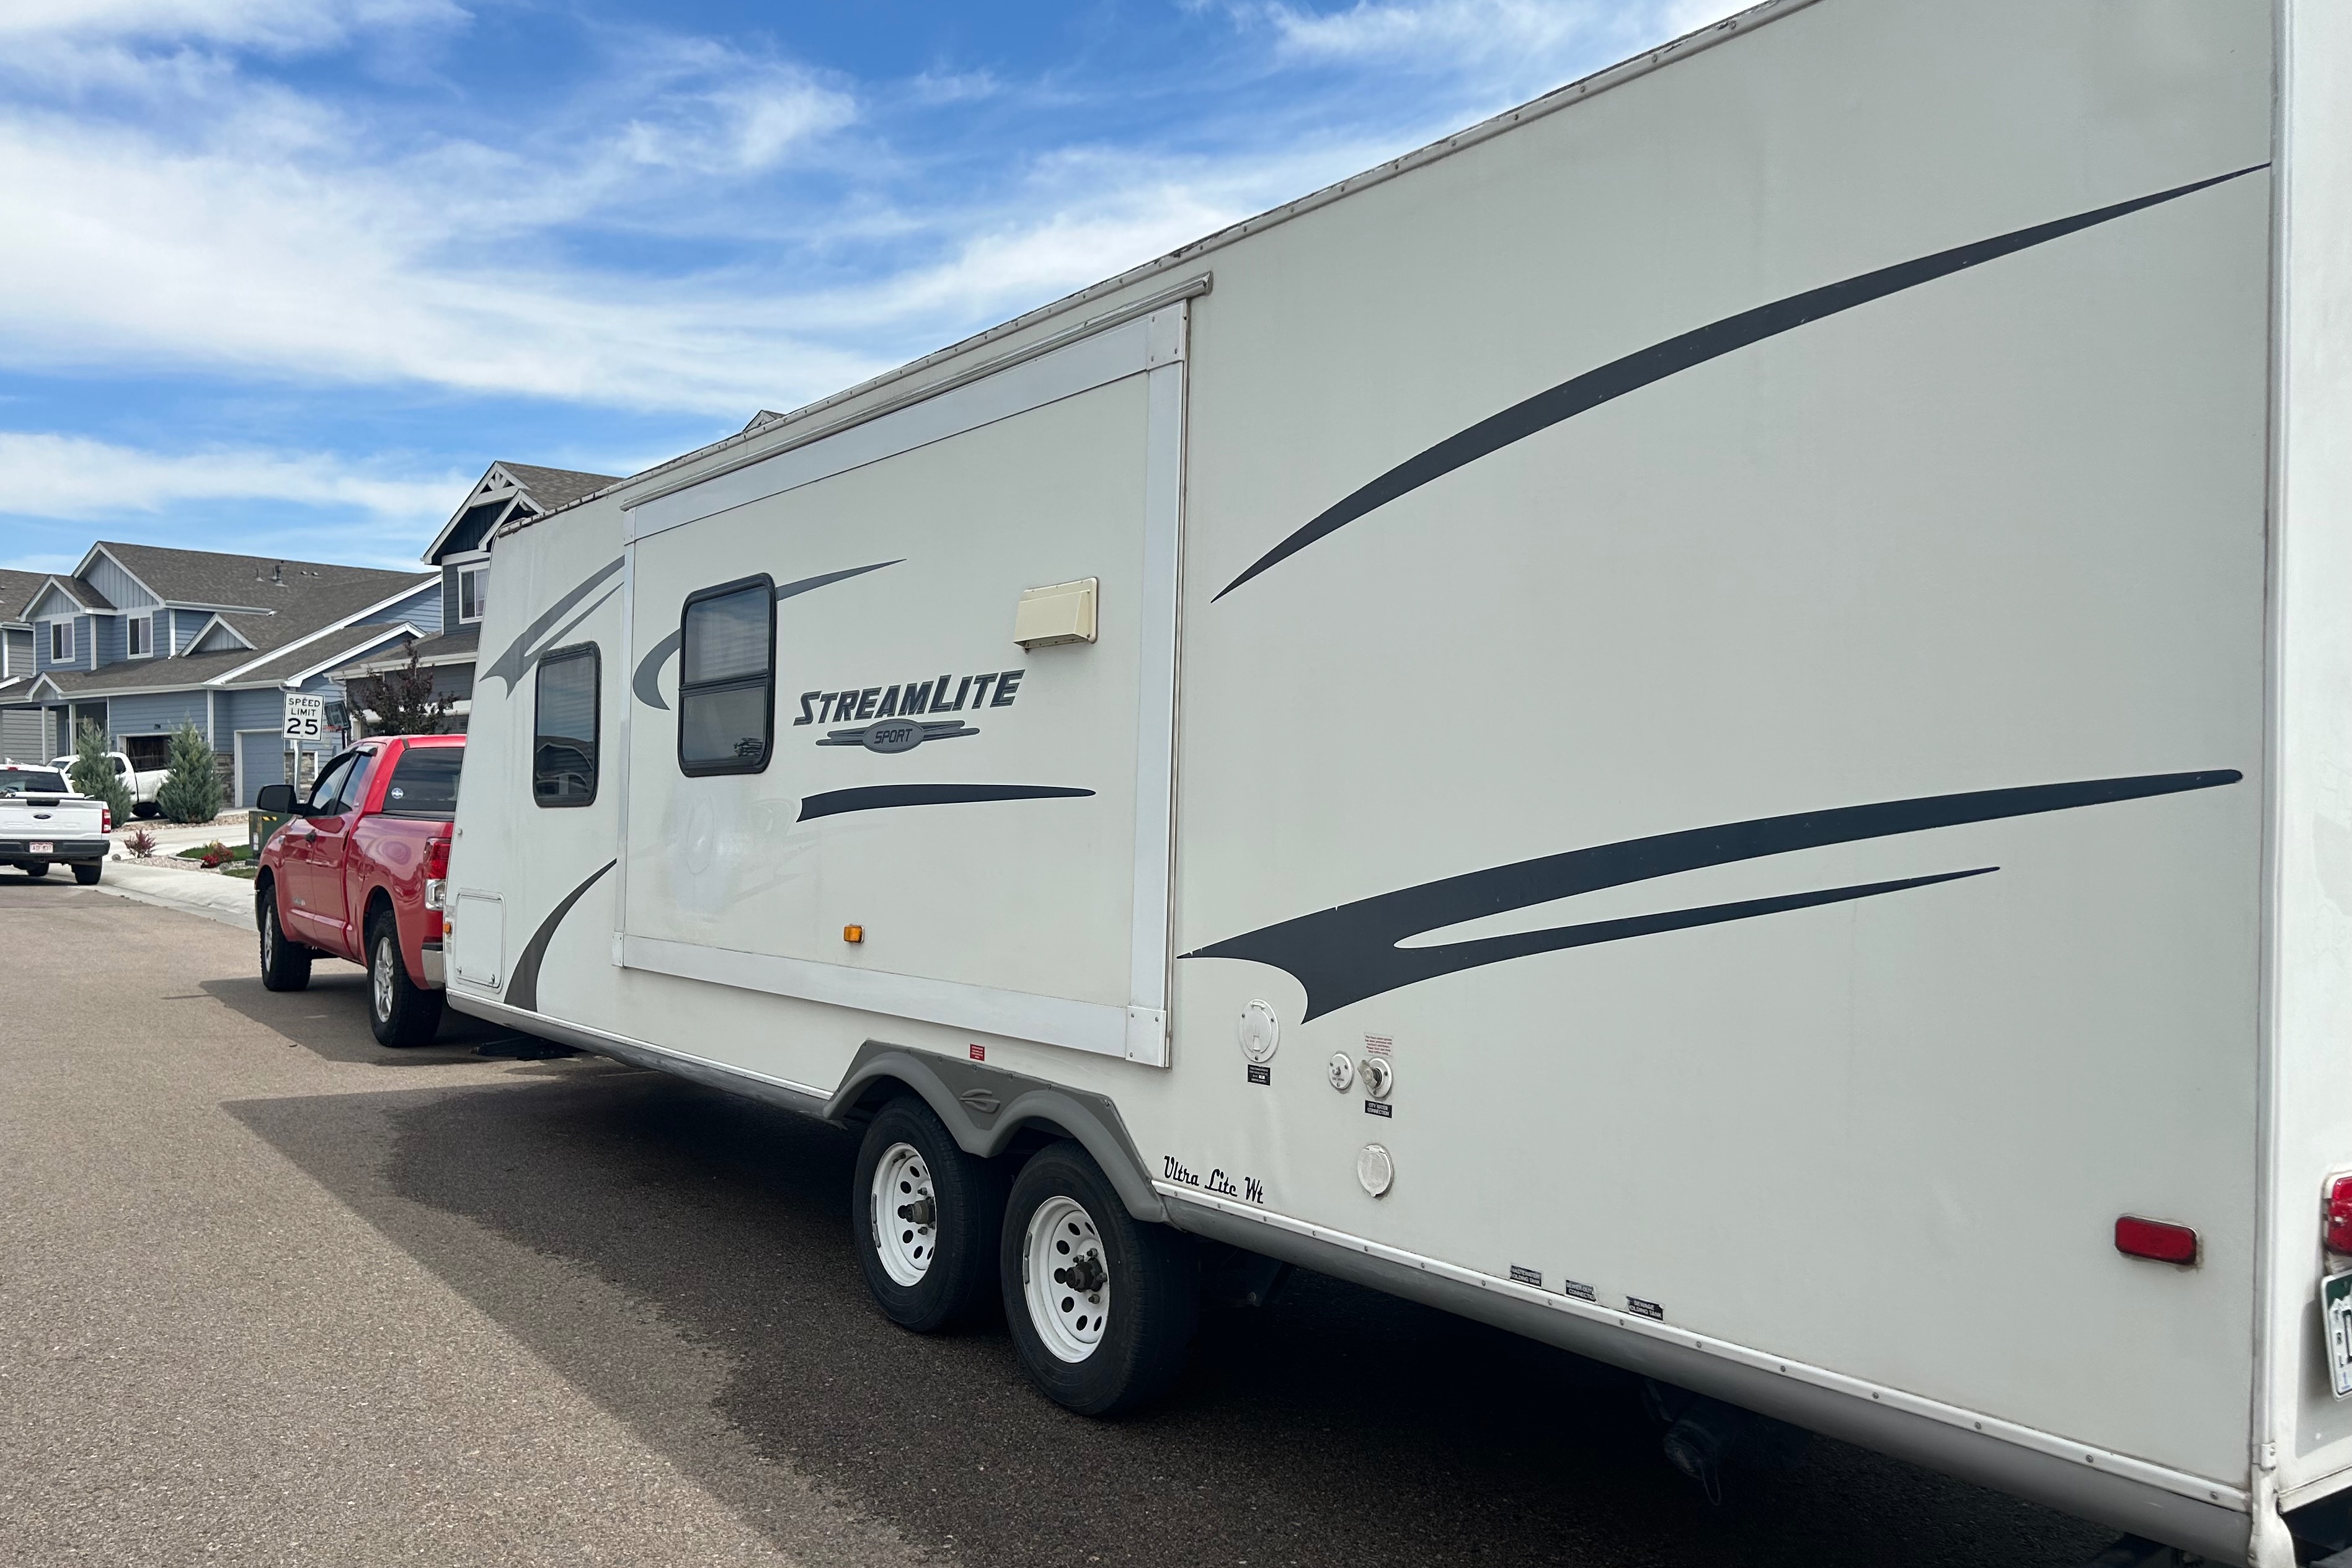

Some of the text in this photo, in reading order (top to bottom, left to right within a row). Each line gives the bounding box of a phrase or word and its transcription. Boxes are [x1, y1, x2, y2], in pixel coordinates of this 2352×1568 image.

[288, 698, 321, 707] SPEED
[792, 669, 1026, 726] STREAMLITE
[291, 708, 316, 717] LIMIT
[286, 718, 318, 735] 25
[874, 728, 913, 744] SPORT
[1164, 1155, 1264, 1203] Ultra Lite Wt
